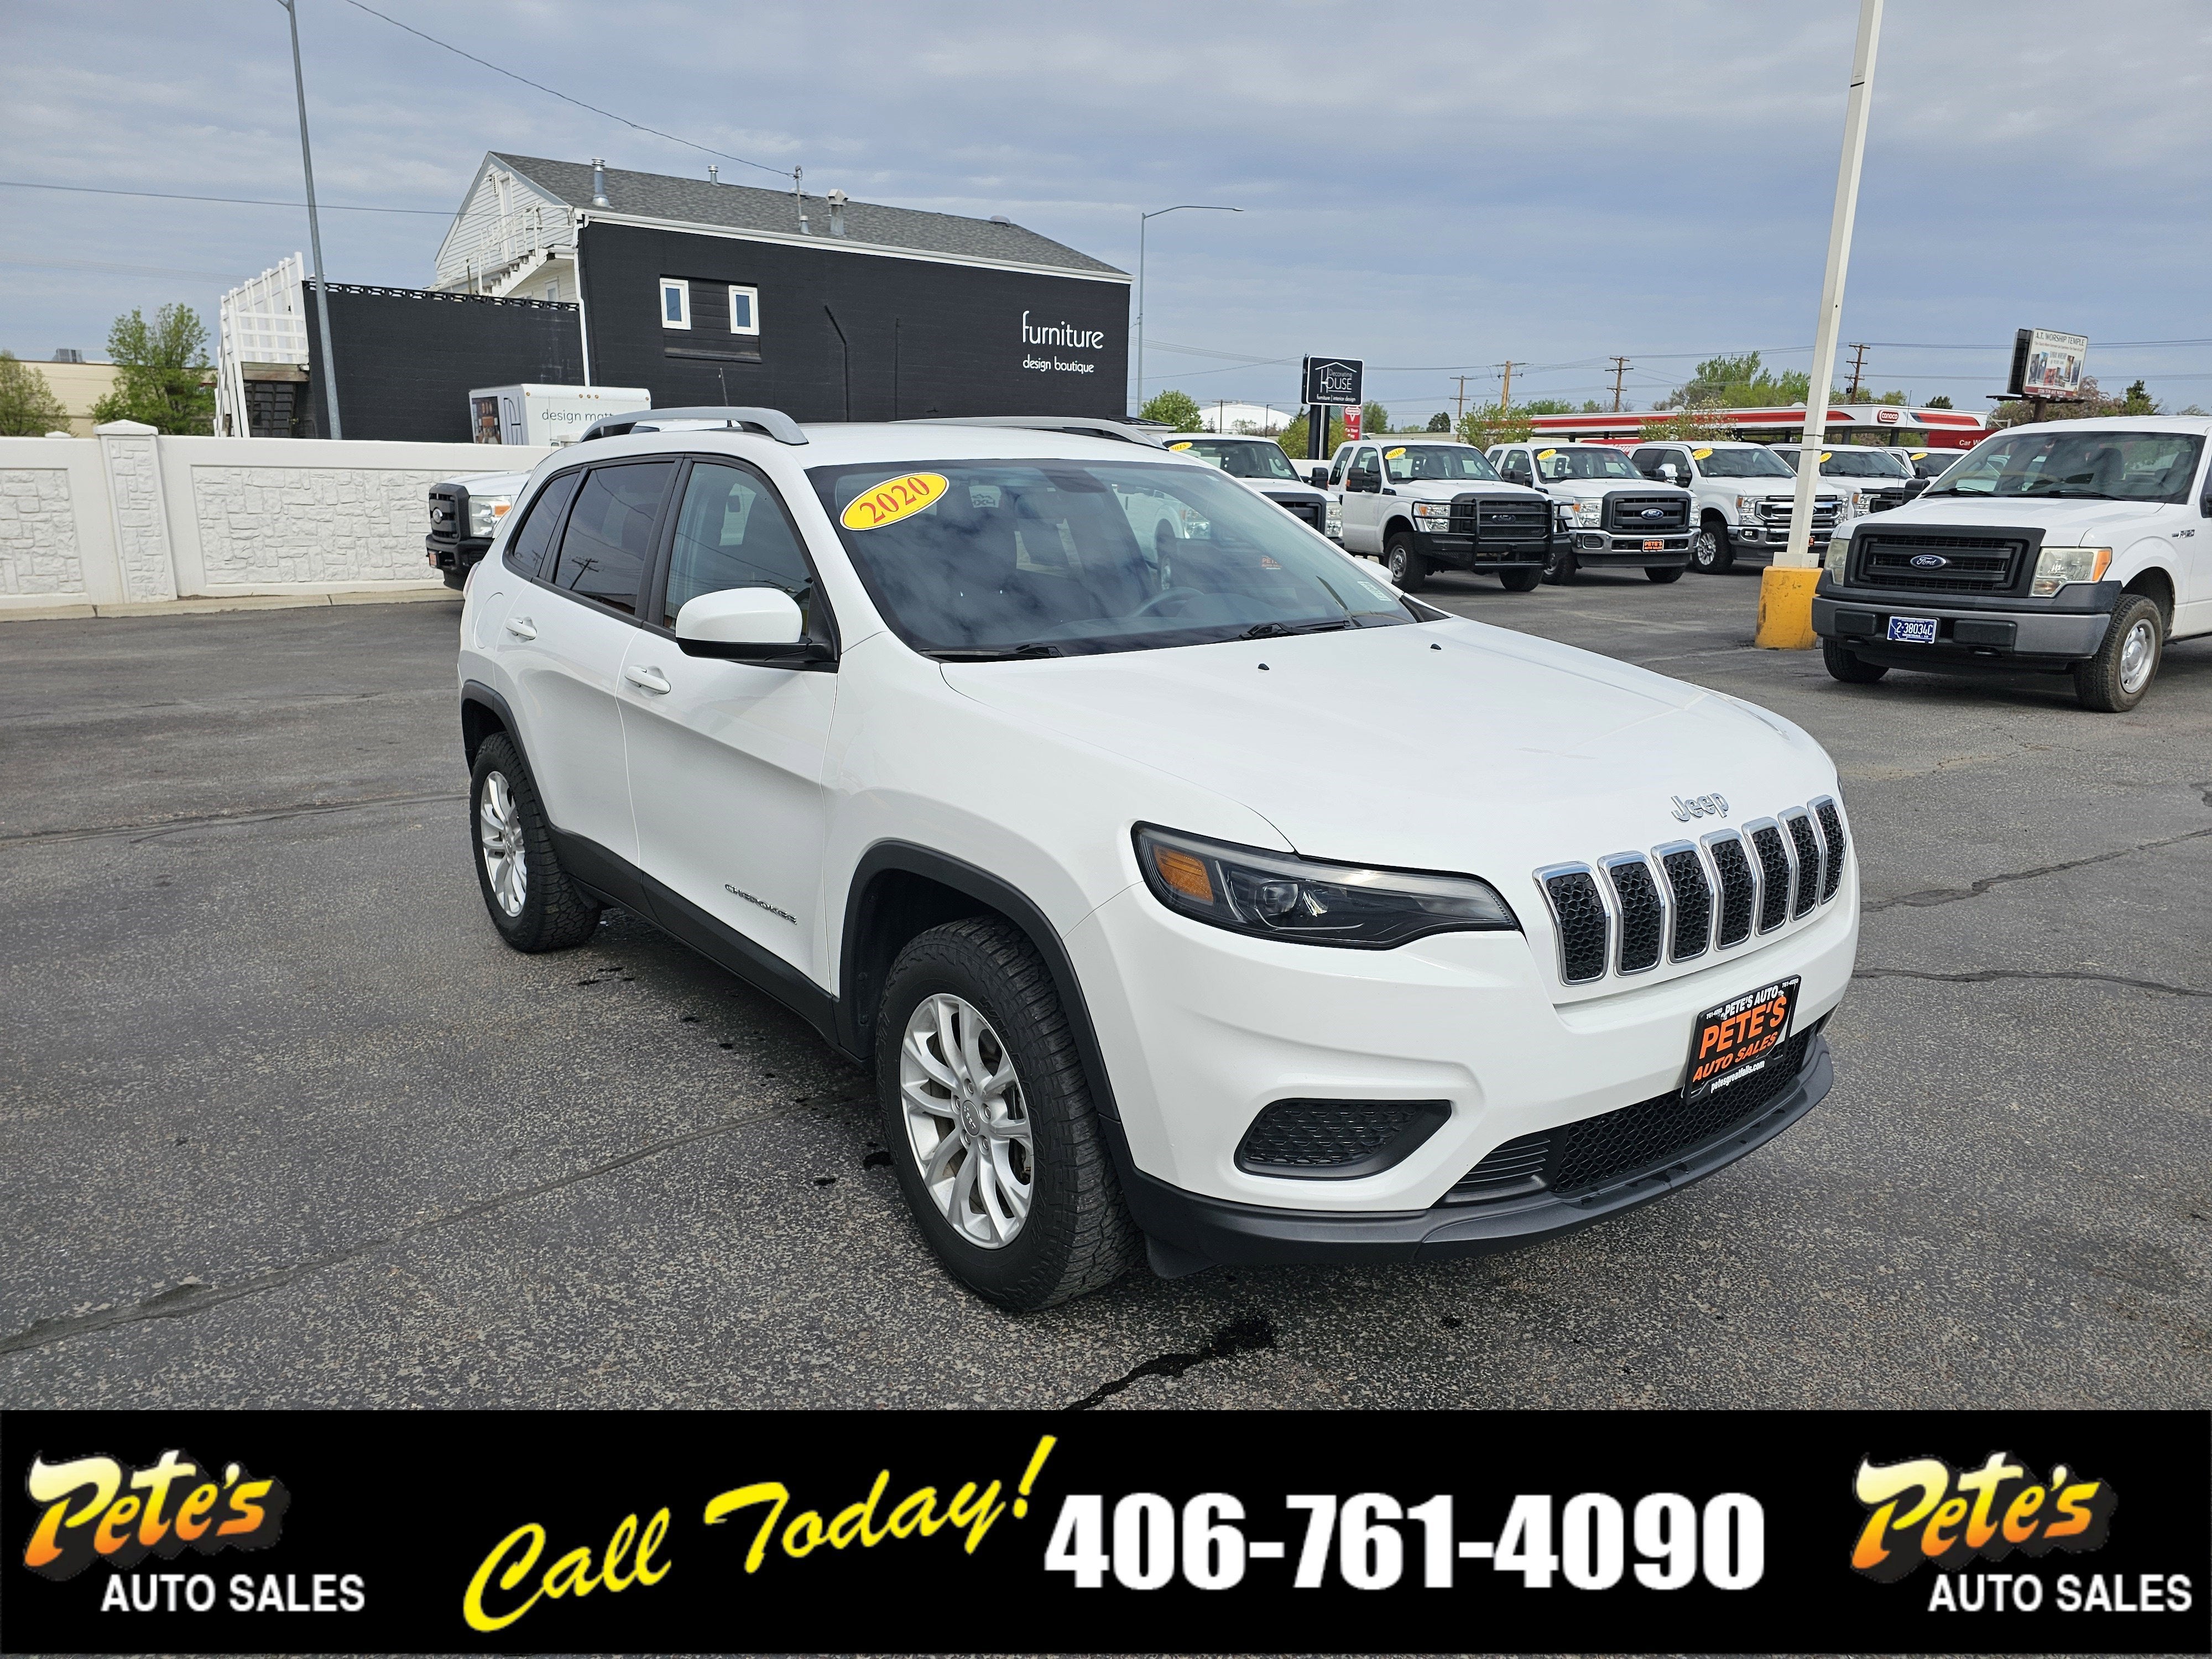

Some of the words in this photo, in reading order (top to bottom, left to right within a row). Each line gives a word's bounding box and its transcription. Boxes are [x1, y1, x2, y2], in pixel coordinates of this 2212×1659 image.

[1022, 310, 1104, 349] furniture
[2035, 332, 2044, 340] A.T.
[2046, 333, 2067, 343] WORSHIP
[2068, 336, 2085, 347] TEMPLE
[1022, 354, 1051, 372] design
[1053, 356, 1094, 374] boutique
[1329, 368, 1353, 378] Decorating
[542, 408, 582, 424] design
[859, 477, 930, 524] 2020
[1916, 556, 1937, 566] Ford
[1670, 792, 1729, 823] Jeep
[724, 884, 797, 925] CHEROKEE
[1725, 995, 1754, 1018] PETE'S
[1754, 985, 1778, 1006] AUTO
[1699, 995, 1787, 1060] PETE'S
[1692, 1053, 1734, 1083] AUTO
[1734, 1031, 1778, 1063] SALES
[1710, 1060, 1765, 1094] petesgreatfalls.com
